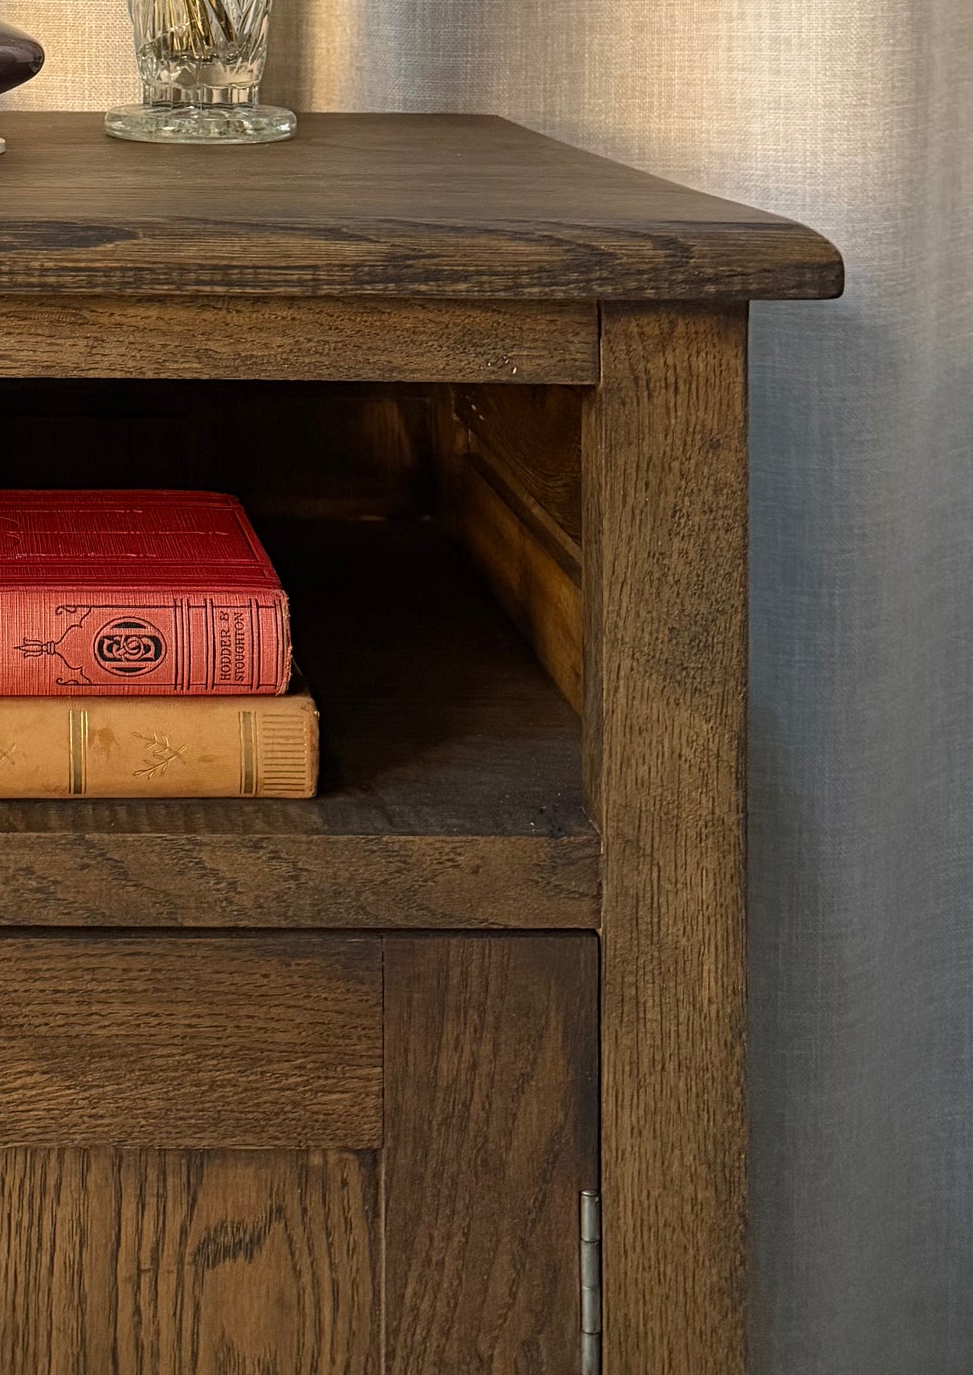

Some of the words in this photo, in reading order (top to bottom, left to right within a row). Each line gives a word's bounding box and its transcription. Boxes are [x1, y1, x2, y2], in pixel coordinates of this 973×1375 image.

[219, 610, 230, 623] &
[220, 629, 232, 682] HODDER
[234, 611, 246, 682] STOUGHTON
